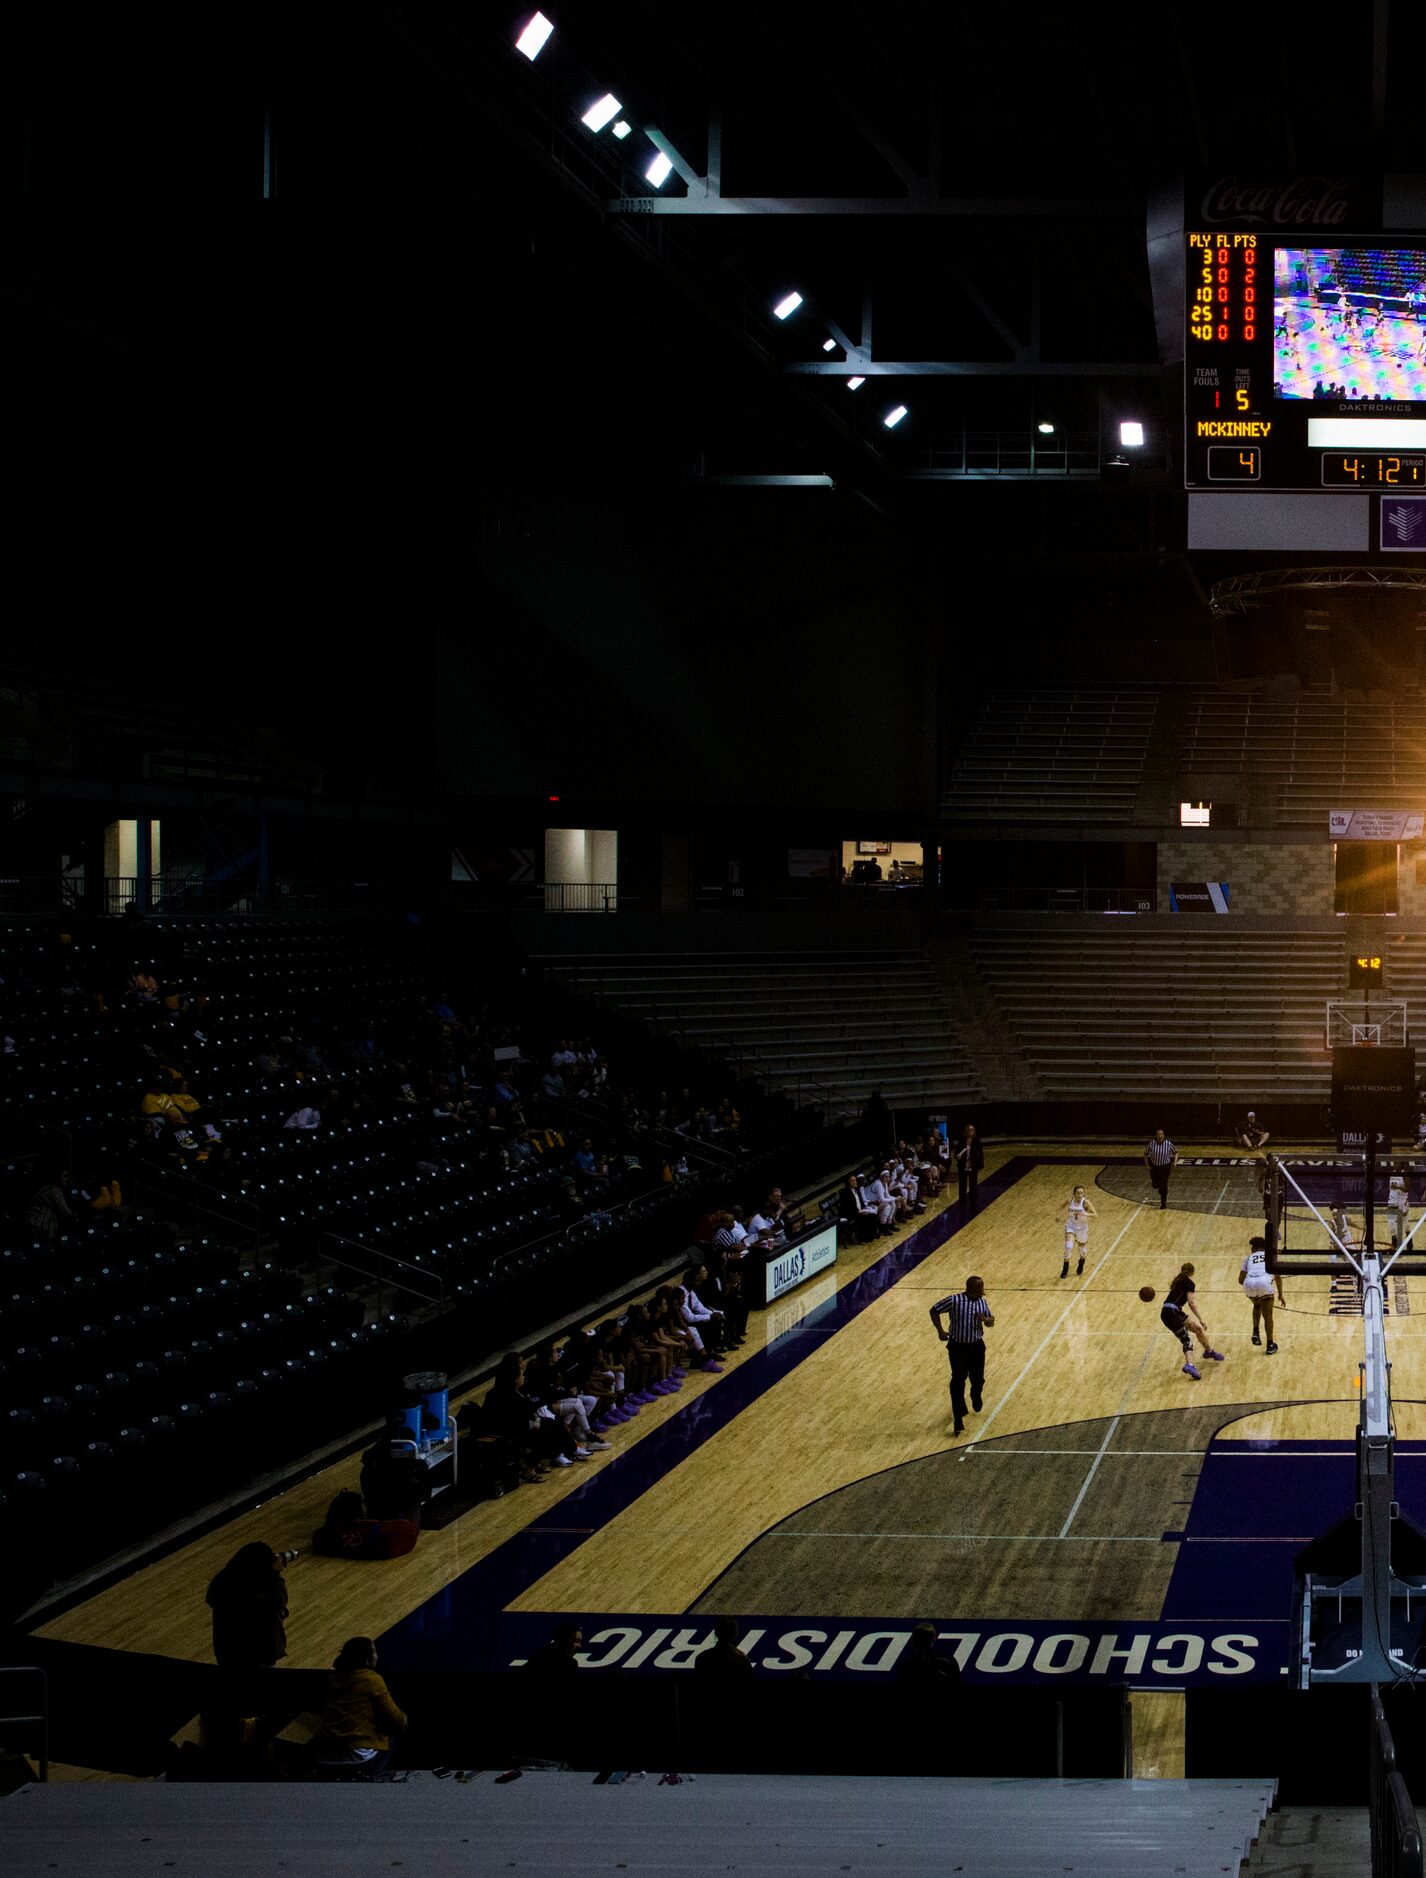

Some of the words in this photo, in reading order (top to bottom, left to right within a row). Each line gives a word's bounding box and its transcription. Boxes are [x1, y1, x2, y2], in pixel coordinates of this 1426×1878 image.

[1189, 234, 1211, 248] PLY
[1216, 235, 1231, 248] FL
[1233, 235, 1257, 248] PTS
[1203, 249, 1212, 264] 3
[1218, 249, 1229, 265] 0
[1244, 249, 1255, 265] 0
[1202, 268, 1212, 283] 5
[1218, 268, 1229, 284] 0
[1244, 268, 1255, 284] 2
[1196, 287, 1212, 303] 10
[1218, 287, 1229, 303] 0
[1244, 287, 1255, 303] 0
[1191, 306, 1212, 321] 25
[1223, 306, 1228, 320] 1
[1244, 306, 1255, 322] 0
[1190, 325, 1212, 341] 40
[1218, 325, 1229, 341] 0
[1244, 325, 1255, 341] 0
[1195, 368, 1217, 377] TEAM
[1235, 375, 1251, 383] OUTS
[1194, 377, 1220, 387] FOULS
[1215, 390, 1220, 408] 1
[1235, 389, 1250, 411] 5
[1339, 403, 1412, 412] DAKTRONICS
[1196, 421, 1272, 437] MCKINNEY
[1239, 452, 1254, 474] 4
[1343, 457, 1400, 483] 4:12
[1402, 459, 1424, 467] PERIOD
[1412, 467, 1418, 480] 1
[1137, 901, 1151, 910] 103
[1357, 957, 1381, 969] 4:12
[1343, 1084, 1403, 1092] DAKTRONICS
[1176, 1158, 1257, 1166] ELLIS
[1252, 1254, 1266, 1264] 25
[773, 1254, 799, 1290] DALLAS
[811, 1245, 830, 1263] Athletics
[937, 1632, 1260, 1676] SCHOOL
